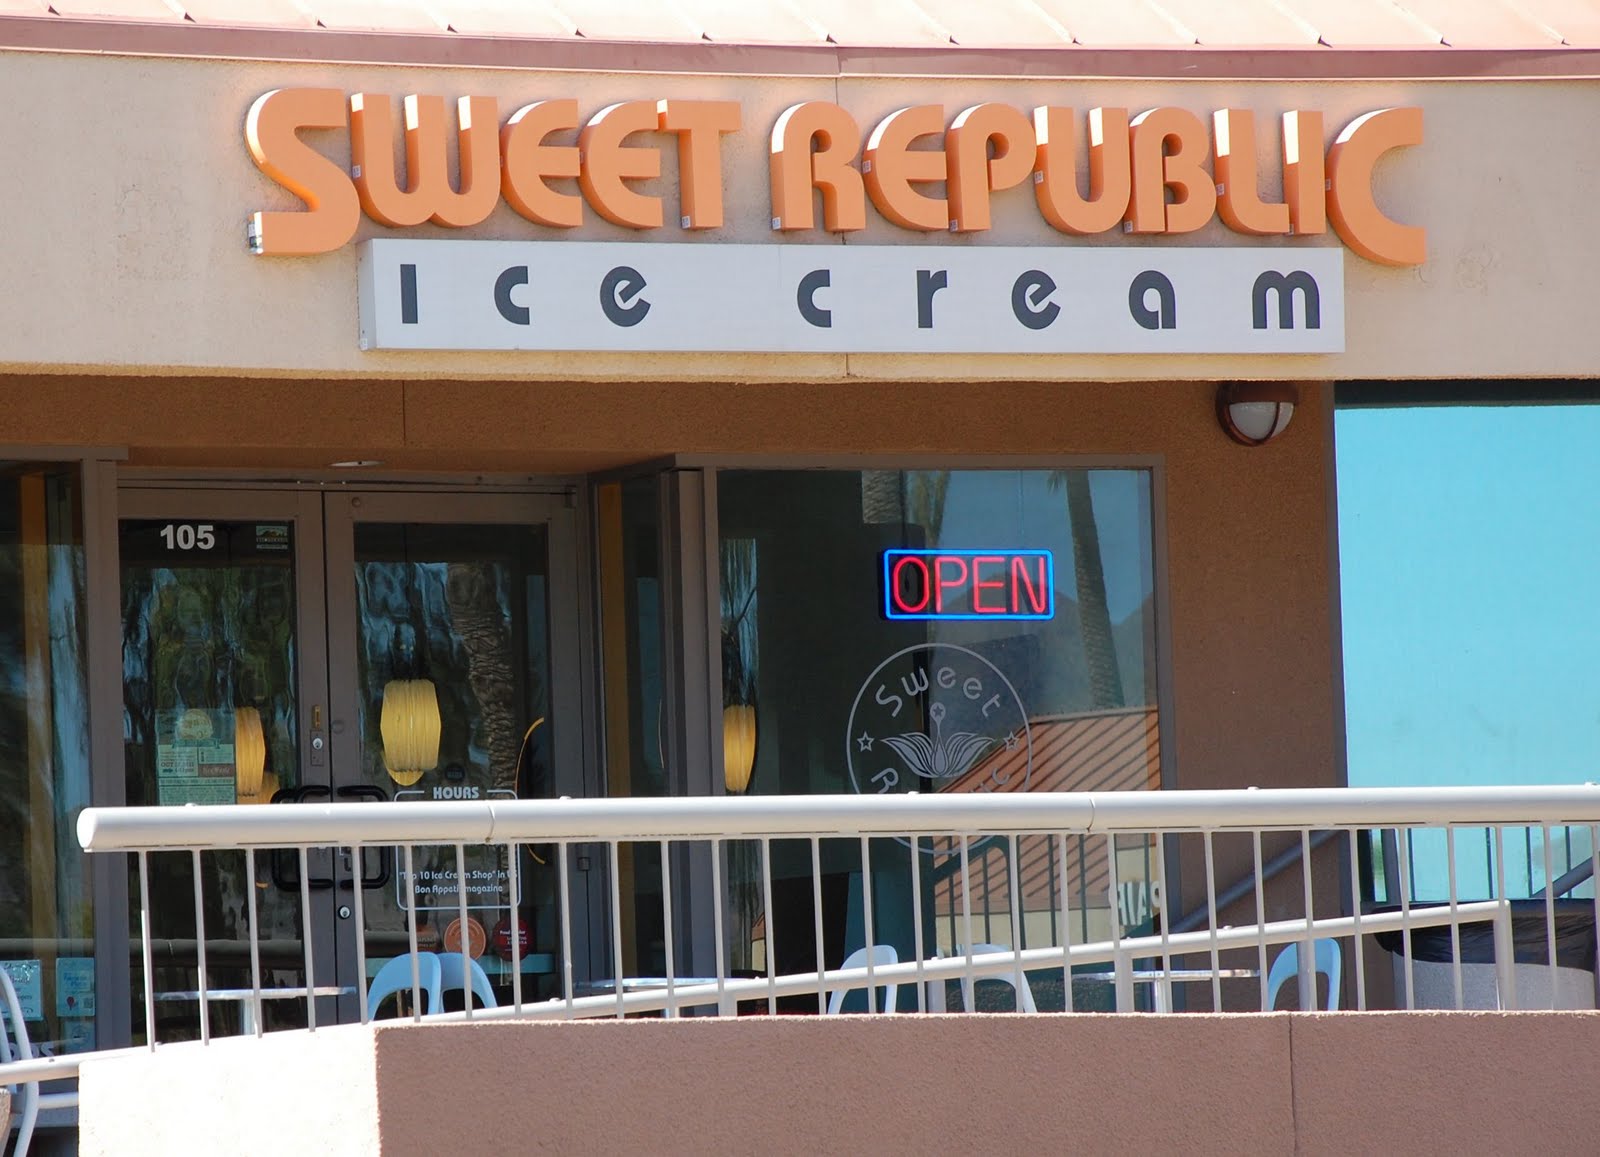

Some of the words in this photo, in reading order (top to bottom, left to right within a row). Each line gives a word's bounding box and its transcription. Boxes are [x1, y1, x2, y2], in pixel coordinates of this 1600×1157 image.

[245, 87, 742, 256] SWEET
[770, 101, 1427, 267] REPUBLIC
[797, 269, 1321, 330] cream
[160, 524, 216, 550] 105
[893, 556, 1046, 613] OPEN
[875, 666, 1001, 718] Sweet
[433, 786, 480, 799] HOURS
[399, 871, 417, 881] "Tp
[420, 871, 430, 880] 10
[432, 871, 443, 880] Ice
[445, 870, 471, 880] Crem
[415, 885, 431, 894] Bon
[432, 884, 462, 895] Appeti
[465, 884, 503, 895] magazine
